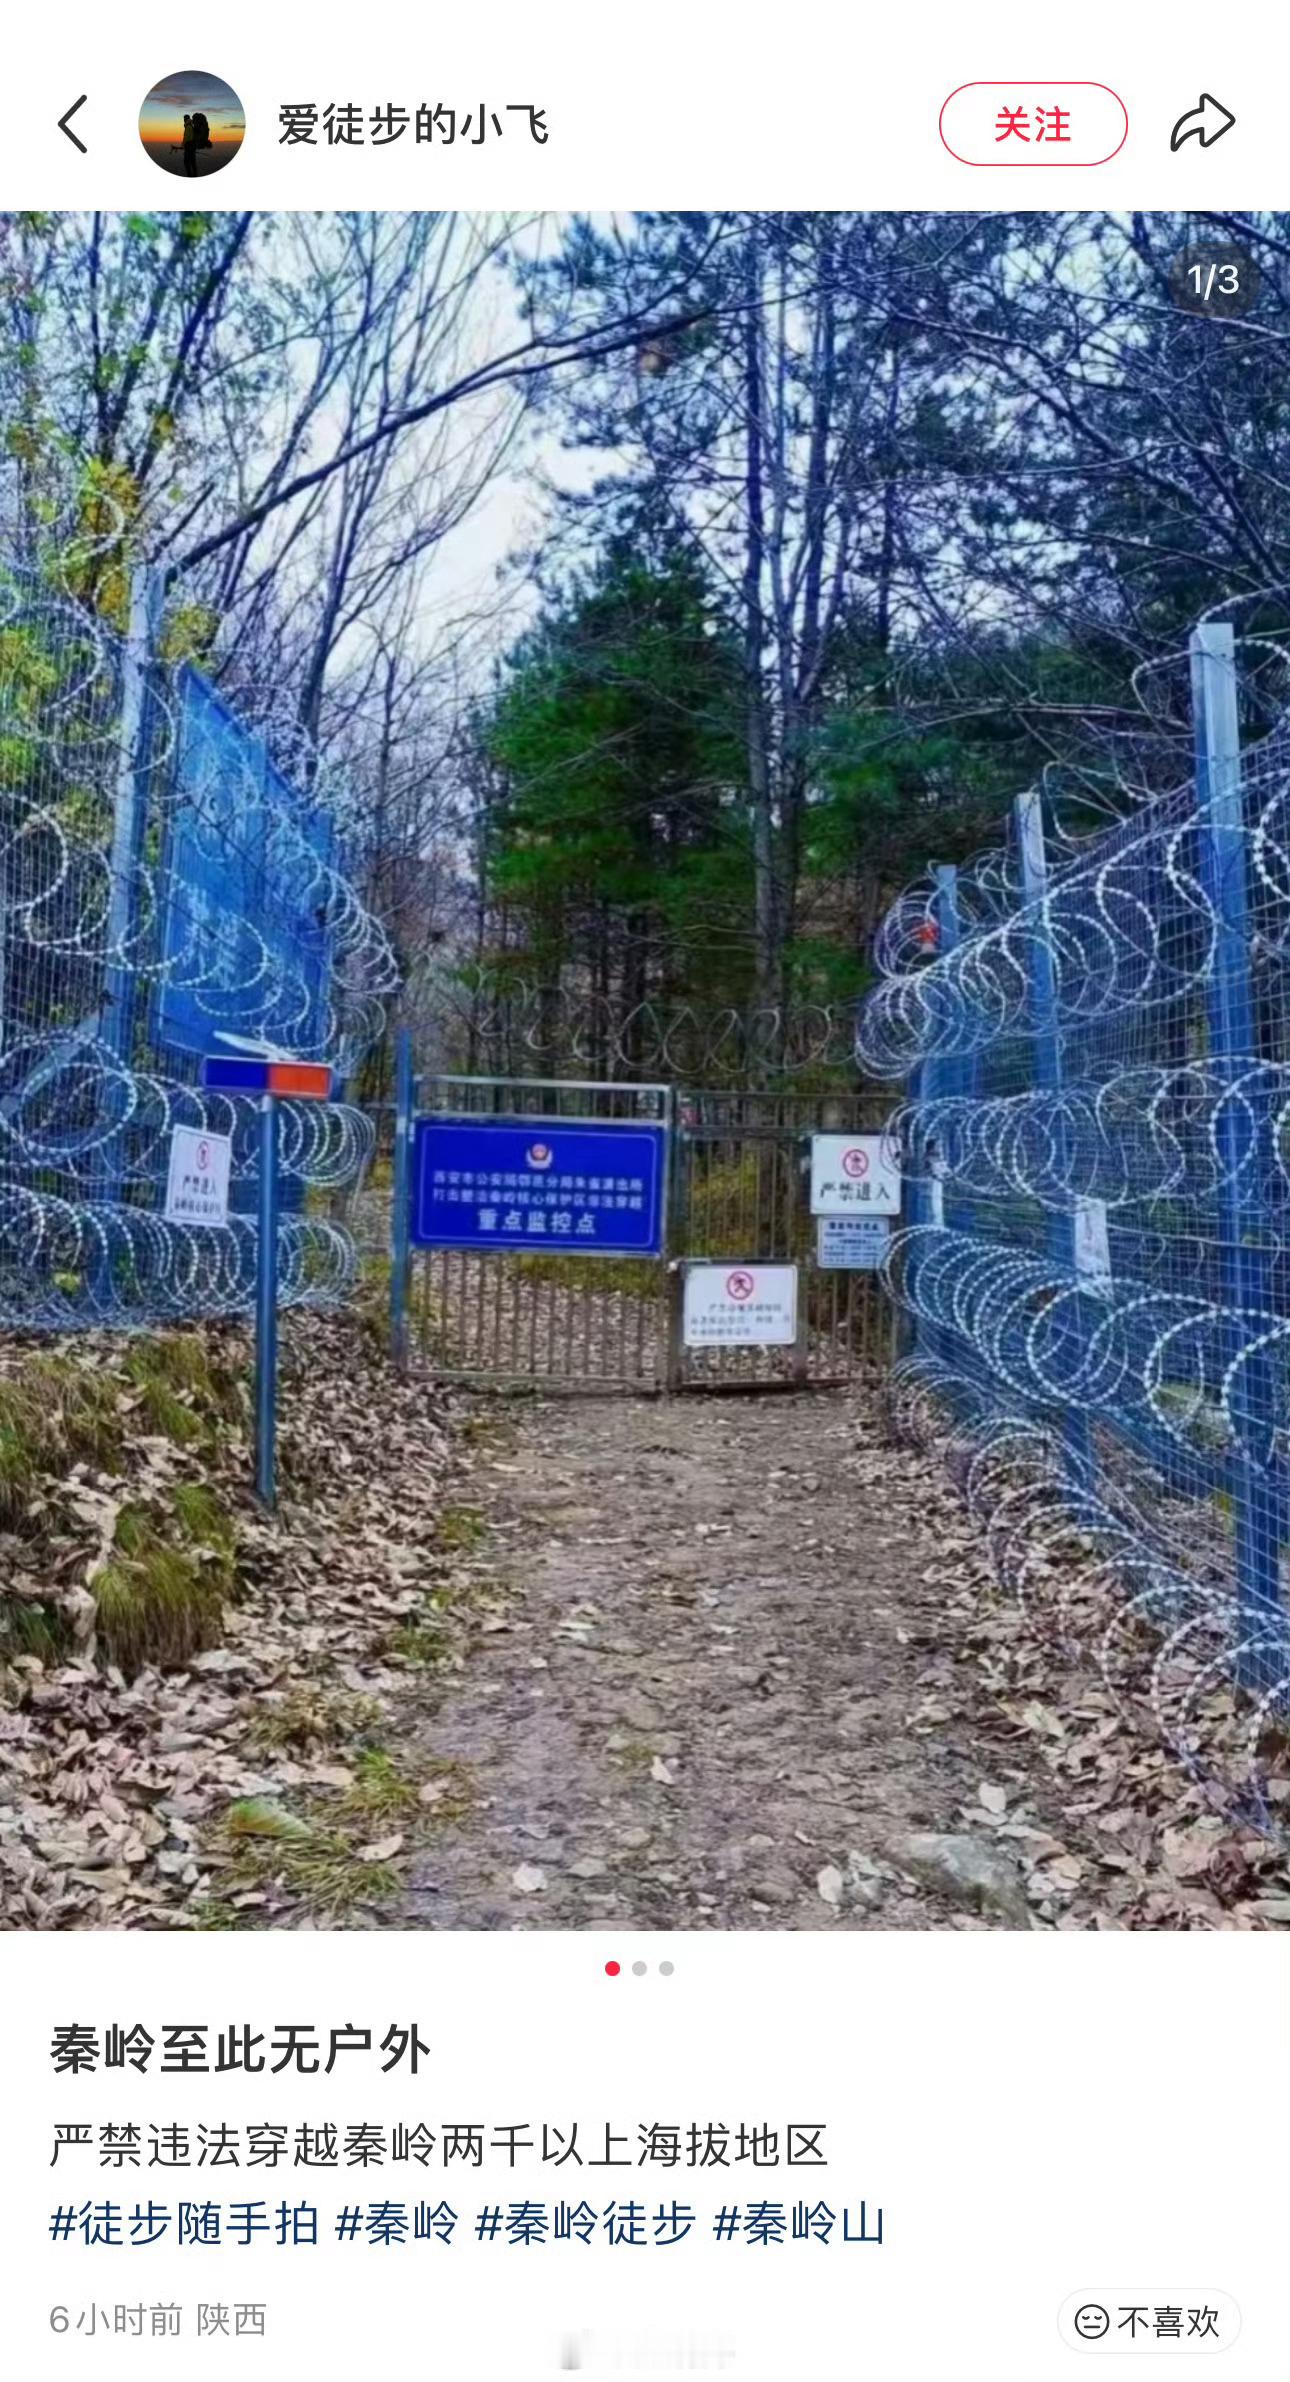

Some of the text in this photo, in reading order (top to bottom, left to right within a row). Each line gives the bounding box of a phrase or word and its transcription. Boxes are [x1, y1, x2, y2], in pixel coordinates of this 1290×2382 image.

[820, 1182, 890, 1201] 严禁进入
[478, 1209, 596, 1234] 重点监控点
